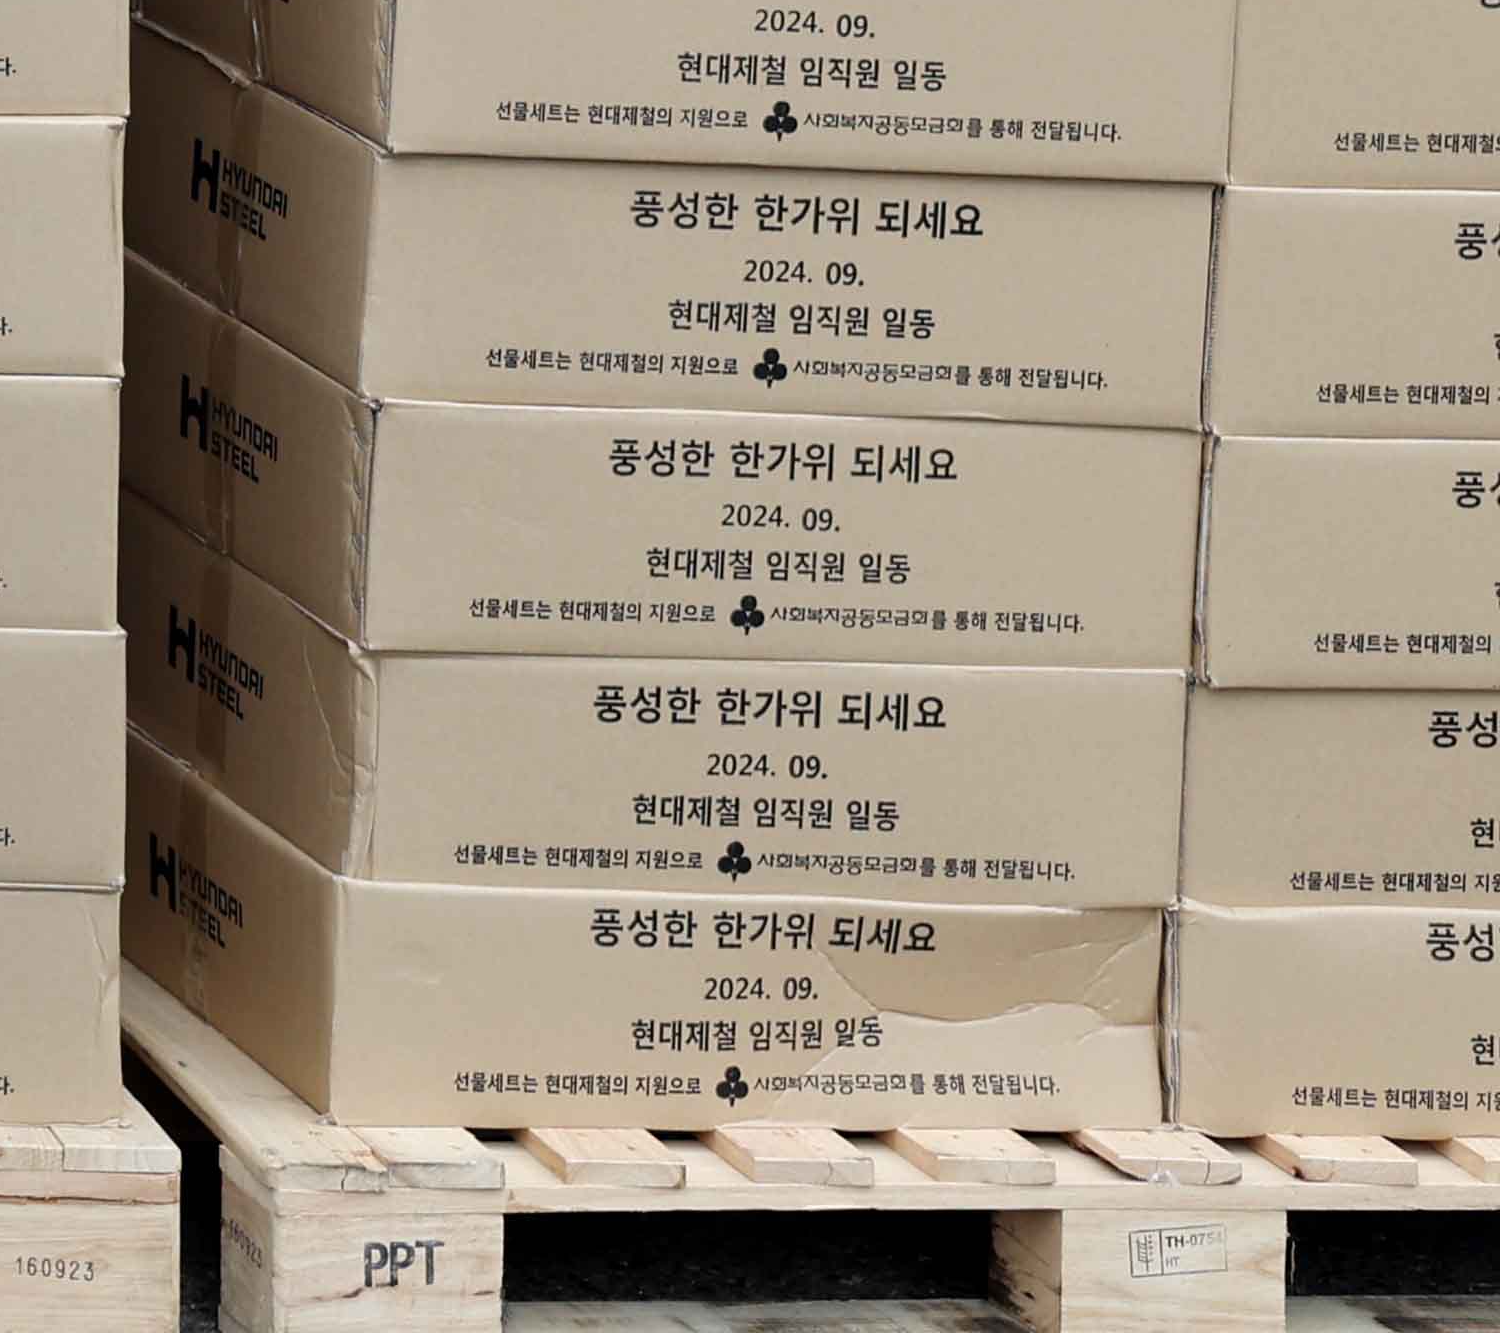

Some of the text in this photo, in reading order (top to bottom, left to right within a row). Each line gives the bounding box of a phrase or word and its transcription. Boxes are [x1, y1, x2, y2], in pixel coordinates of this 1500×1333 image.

[754, 8, 875, 39] 2024. 09.
[677, 51, 947, 93] 현대제철 임직원 일동
[496, 100, 581, 124] 선물세트는
[587, 104, 673, 128] 현대제철의
[680, 108, 749, 129] 지원으로
[989, 118, 1024, 140] 통해
[1031, 120, 1122, 144] 전달됩니다.
[211, 394, 278, 462] HYUNDAI
[211, 432, 260, 484] STEEL
[15, 1255, 94, 1282] 160923
[364, 1240, 445, 1287] PPT
